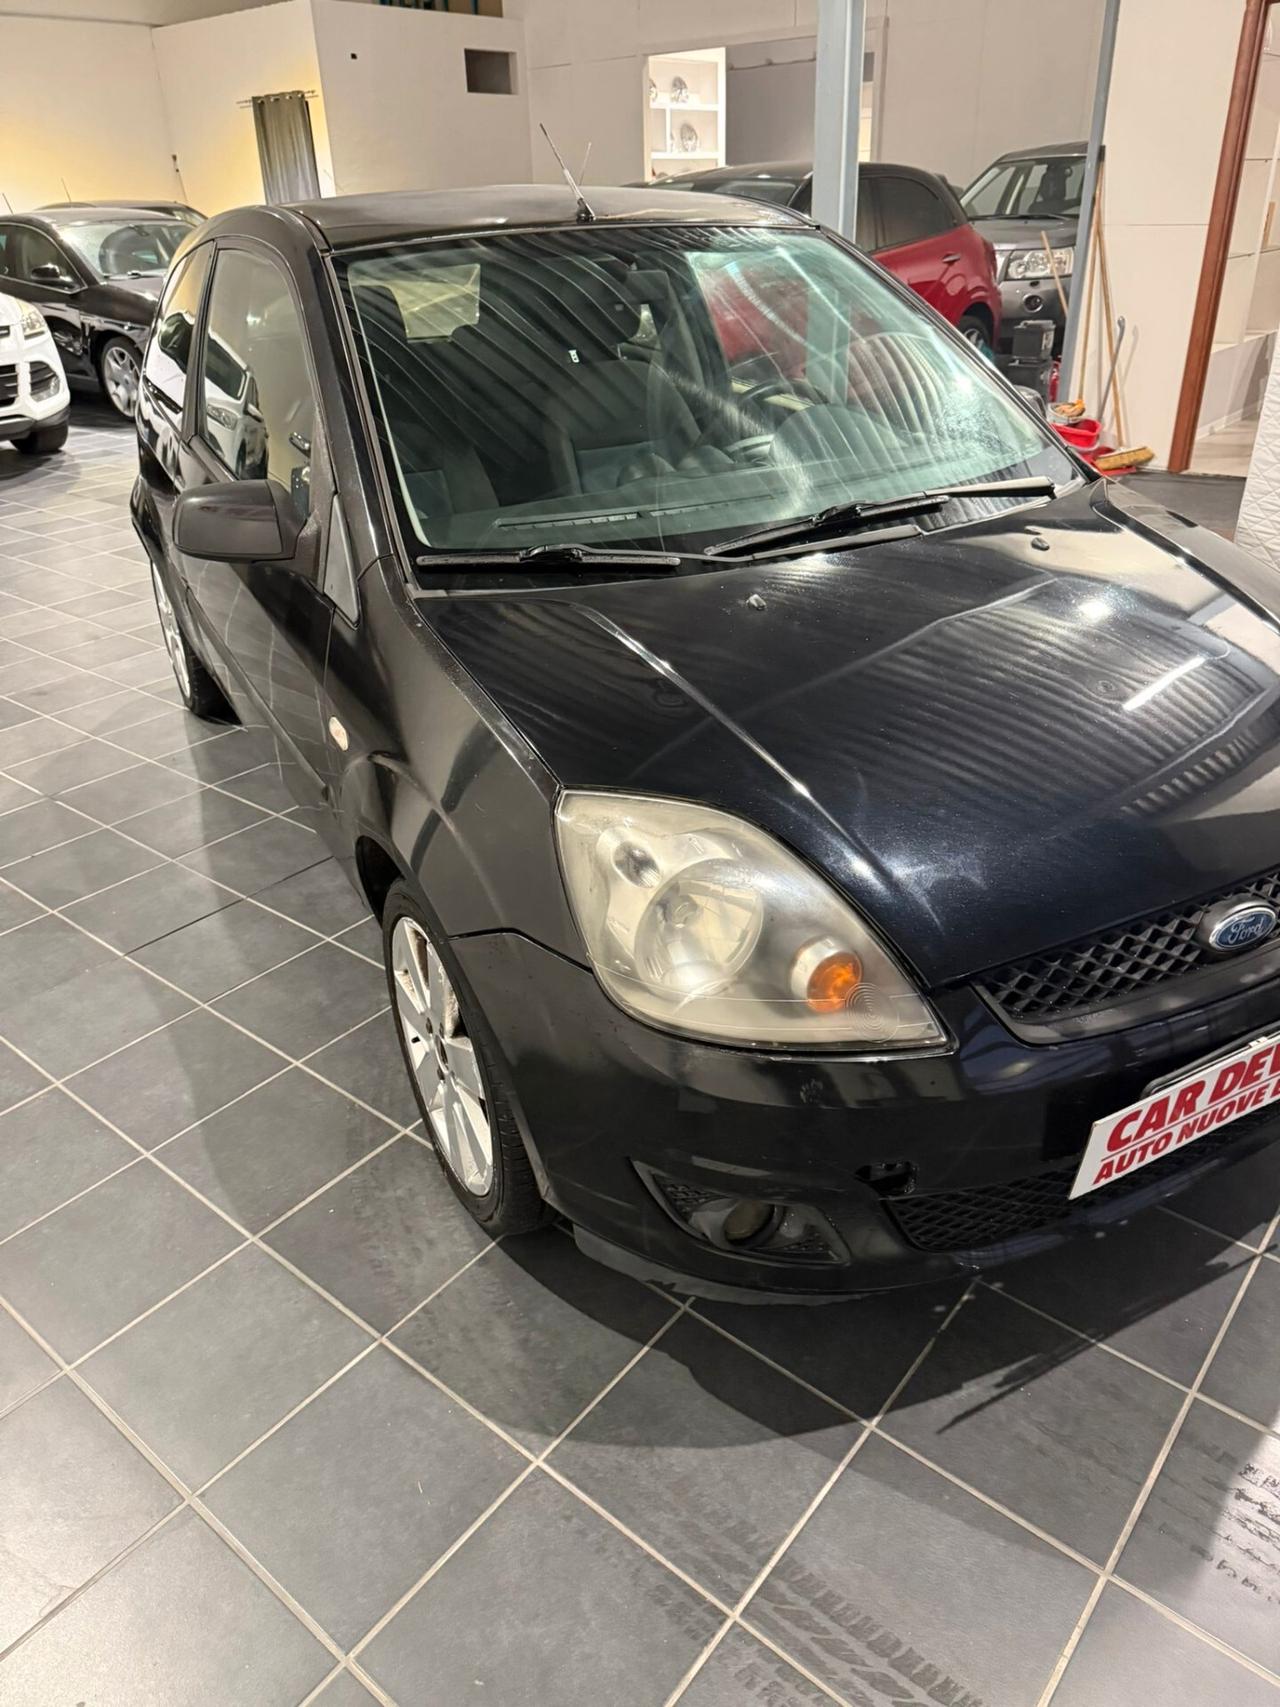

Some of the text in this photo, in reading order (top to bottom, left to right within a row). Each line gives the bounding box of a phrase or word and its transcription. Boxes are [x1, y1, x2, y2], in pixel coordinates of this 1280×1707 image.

[1228, 916, 1265, 944] Ford
[1093, 1083, 1271, 1185] AUTO NUOVE
[1107, 1080, 1206, 1152] CAR
